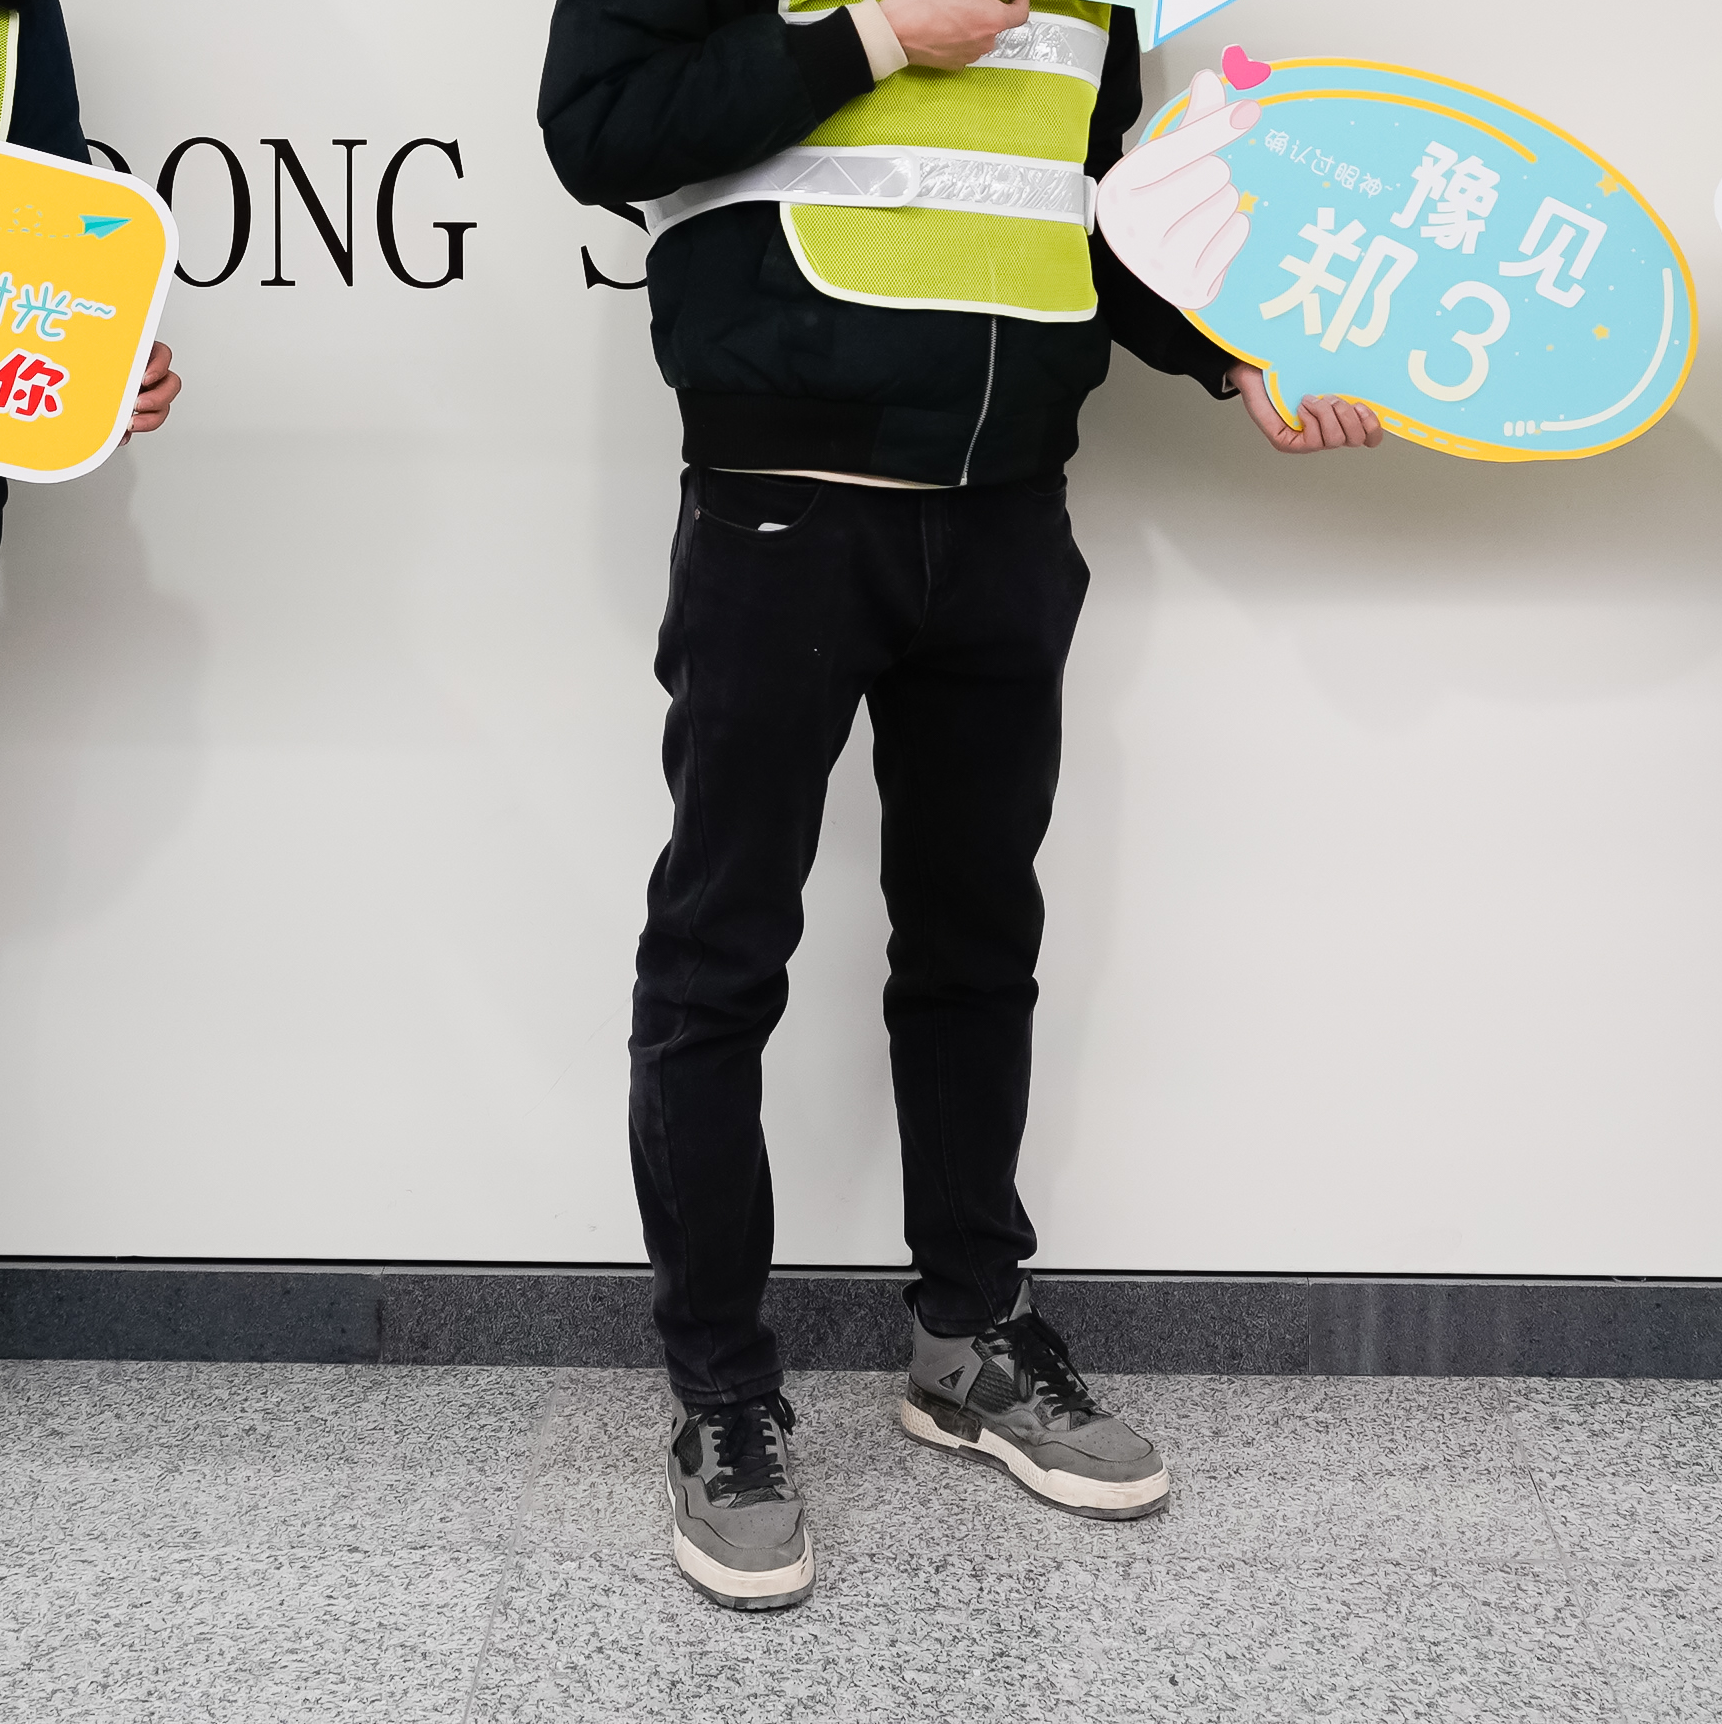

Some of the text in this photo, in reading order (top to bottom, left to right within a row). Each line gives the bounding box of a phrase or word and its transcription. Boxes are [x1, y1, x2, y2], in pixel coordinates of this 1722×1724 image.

[86, 137, 478, 289] ONG
[1389, 140, 1609, 309] 豫见
[1258, 206, 1511, 403] 郑3
